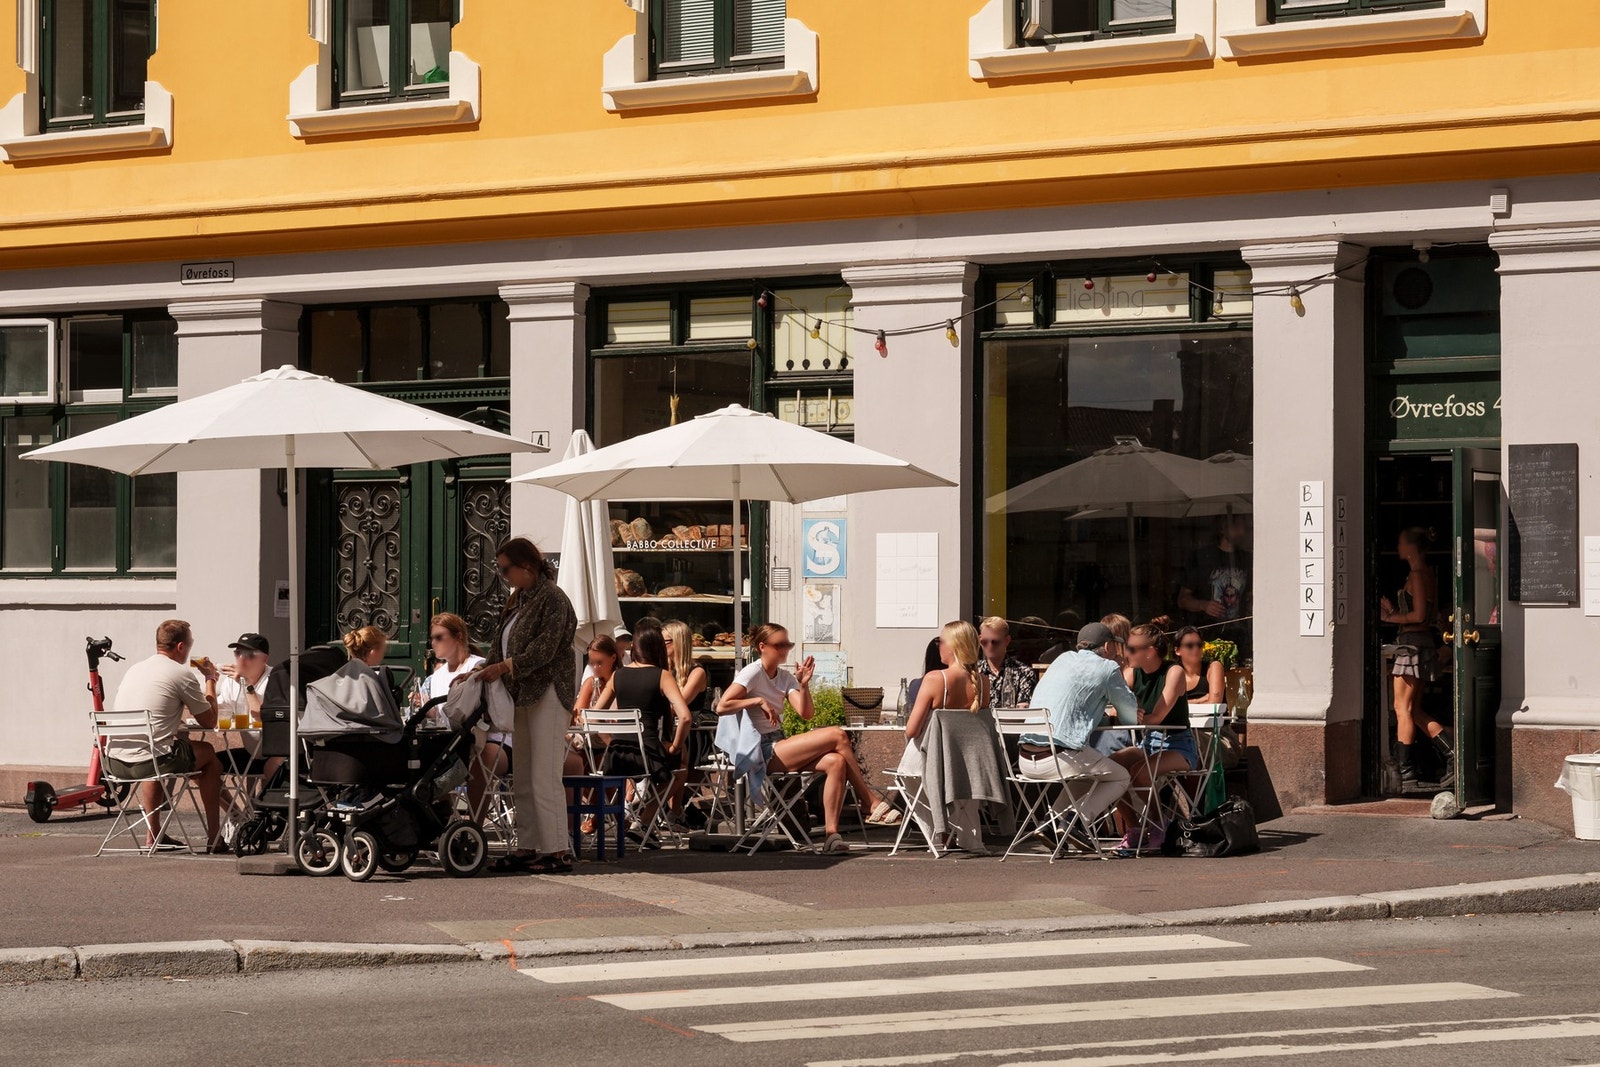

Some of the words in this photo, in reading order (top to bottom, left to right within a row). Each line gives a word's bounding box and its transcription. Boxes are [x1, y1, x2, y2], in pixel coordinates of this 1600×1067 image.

[186, 267, 229, 279] Øvrefoss
[1069, 281, 1144, 316] liebling
[1389, 394, 1486, 418] Øvrefoss
[626, 540, 658, 549] BABBO
[661, 539, 717, 549] COLLECTIVE
[1302, 484, 1315, 629] BAKERY
